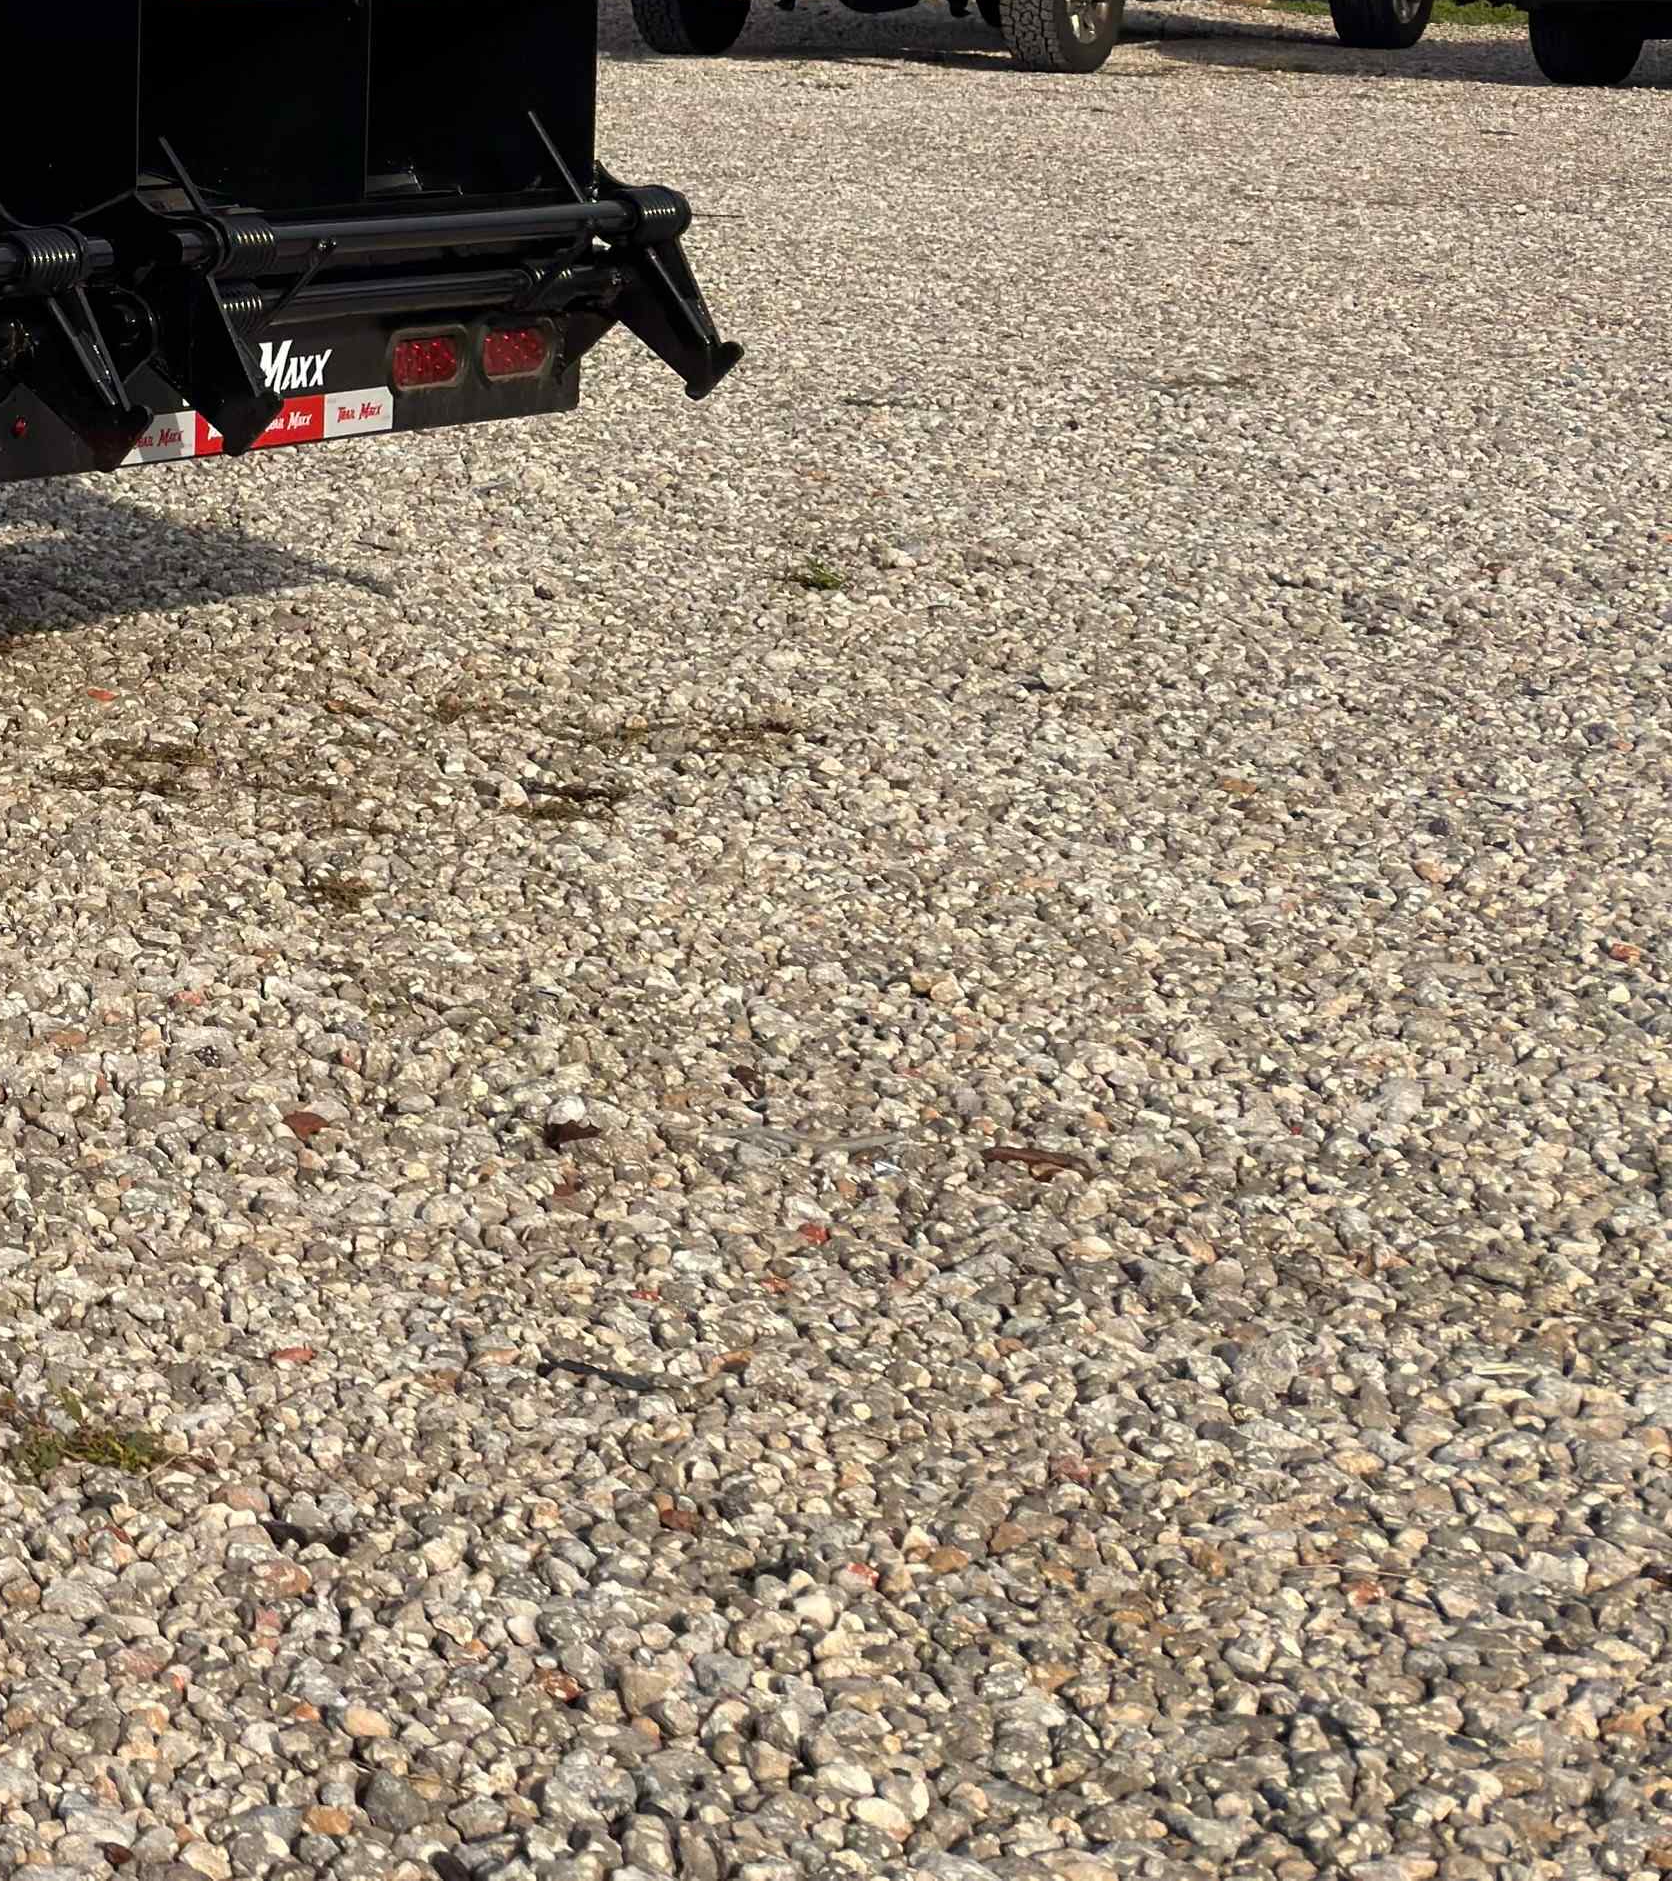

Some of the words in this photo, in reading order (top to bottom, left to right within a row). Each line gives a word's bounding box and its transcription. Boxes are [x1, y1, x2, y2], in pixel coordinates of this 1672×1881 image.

[258, 340, 332, 394] MAXX
[265, 417, 284, 432] RAIL
[287, 411, 312, 430] MAXX
[337, 407, 356, 423] TRAIL
[359, 402, 383, 419] MAXX
